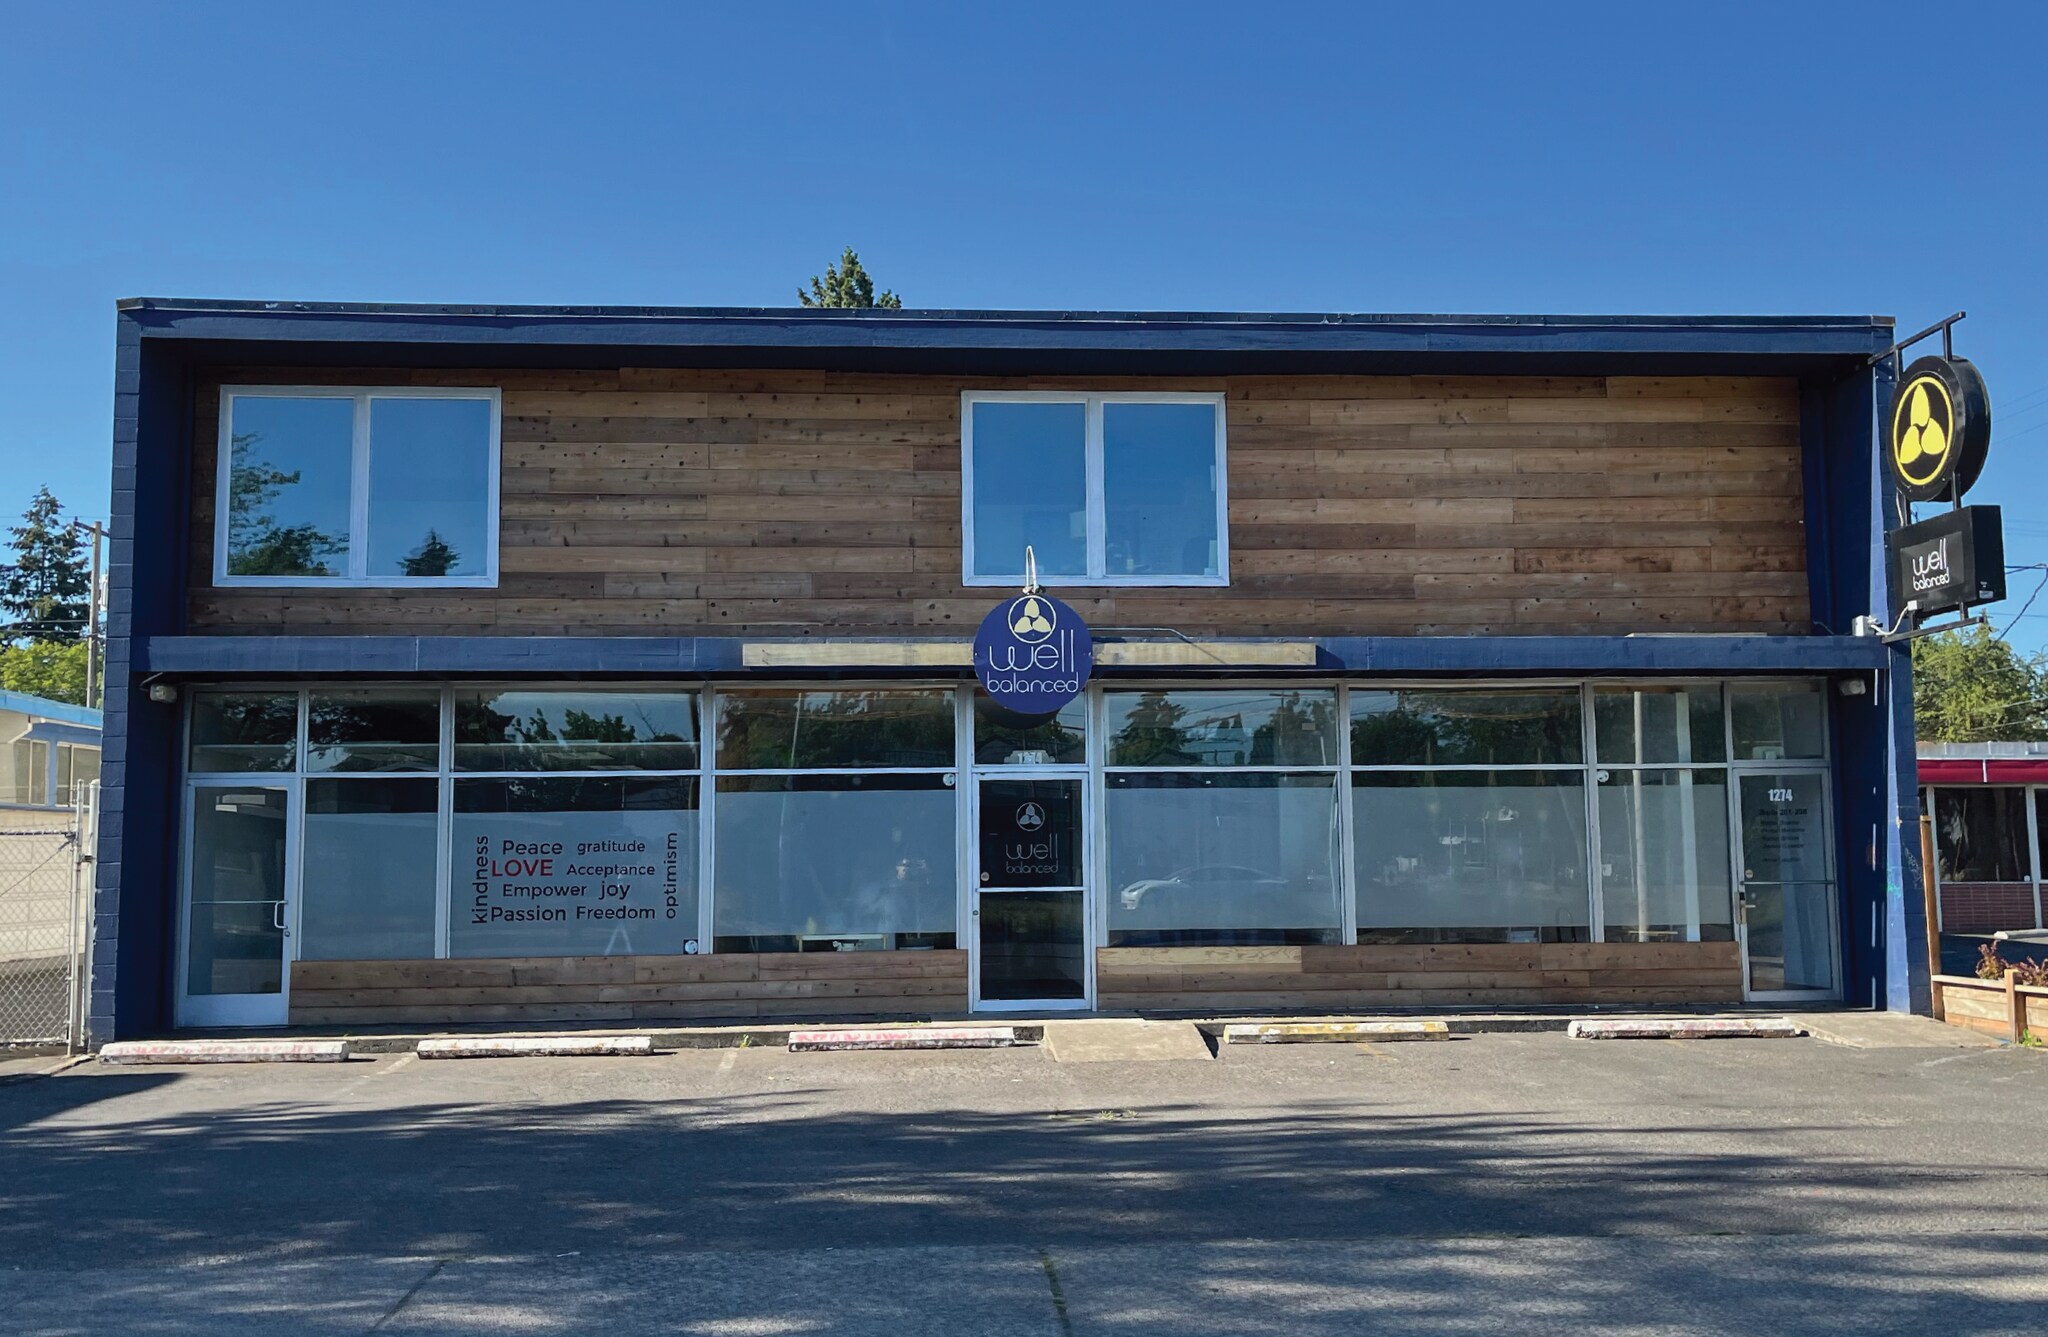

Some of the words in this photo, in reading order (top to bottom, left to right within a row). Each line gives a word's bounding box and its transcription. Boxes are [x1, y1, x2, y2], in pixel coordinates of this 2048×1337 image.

[1912, 537, 1947, 576] well
[1912, 567, 1950, 591] balanced
[989, 629, 1074, 673] well
[987, 671, 1079, 693] balanced
[1767, 788, 1793, 802] 1274
[502, 840, 563, 855] Peace
[577, 840, 646, 855] gratitude
[1005, 833, 1058, 860] well
[491, 859, 553, 877] LOVE
[566, 863, 656, 878] Acceptance
[664, 832, 678, 919] optimism
[1006, 860, 1059, 874] balanced
[472, 835, 488, 924] kindness
[503, 883, 587, 900] Empower
[599, 881, 630, 900] joy
[491, 905, 567, 922] Passion
[576, 905, 656, 920] Freedom
